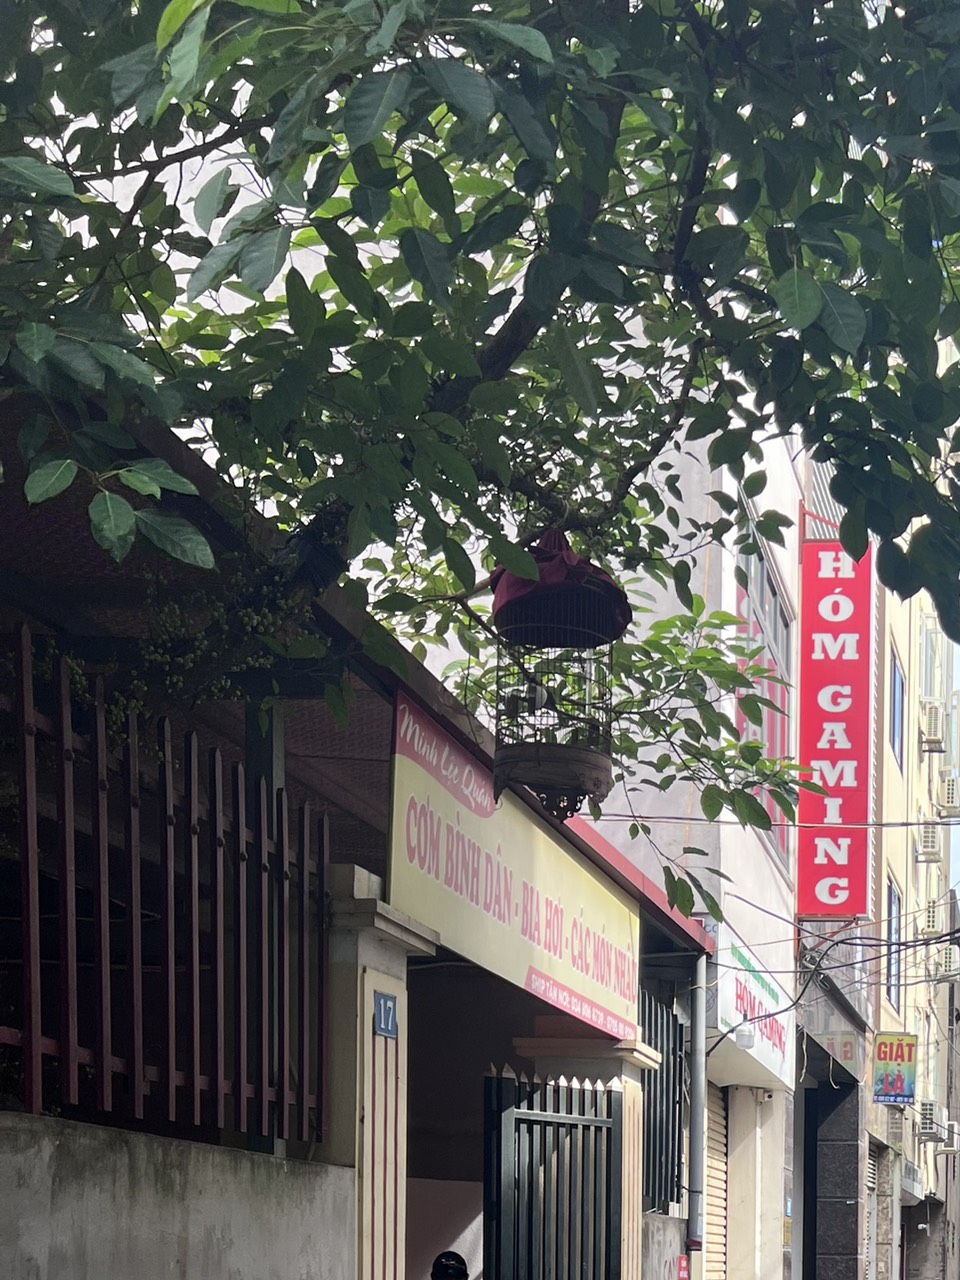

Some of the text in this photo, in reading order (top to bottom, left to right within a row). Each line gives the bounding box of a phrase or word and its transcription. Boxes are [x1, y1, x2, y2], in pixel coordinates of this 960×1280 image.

[810, 551, 859, 905] HÓM GAMING
[400, 704, 437, 766] Minh
[461, 764, 491, 812] Quán
[406, 795, 441, 881] CƠM
[444, 811, 481, 906] BÌNH
[484, 843, 513, 926] DÂN
[521, 880, 541, 946] BIA
[544, 896, 564, 960] HƠI
[571, 907, 590, 976] CÁC
[592, 924, 612, 988] MÓN
[531, 974, 545, 994] SHIP
[379, 998, 394, 1031] 17
[877, 1038, 916, 1066] GIẶT
[883, 1070, 905, 1094] LÀ
